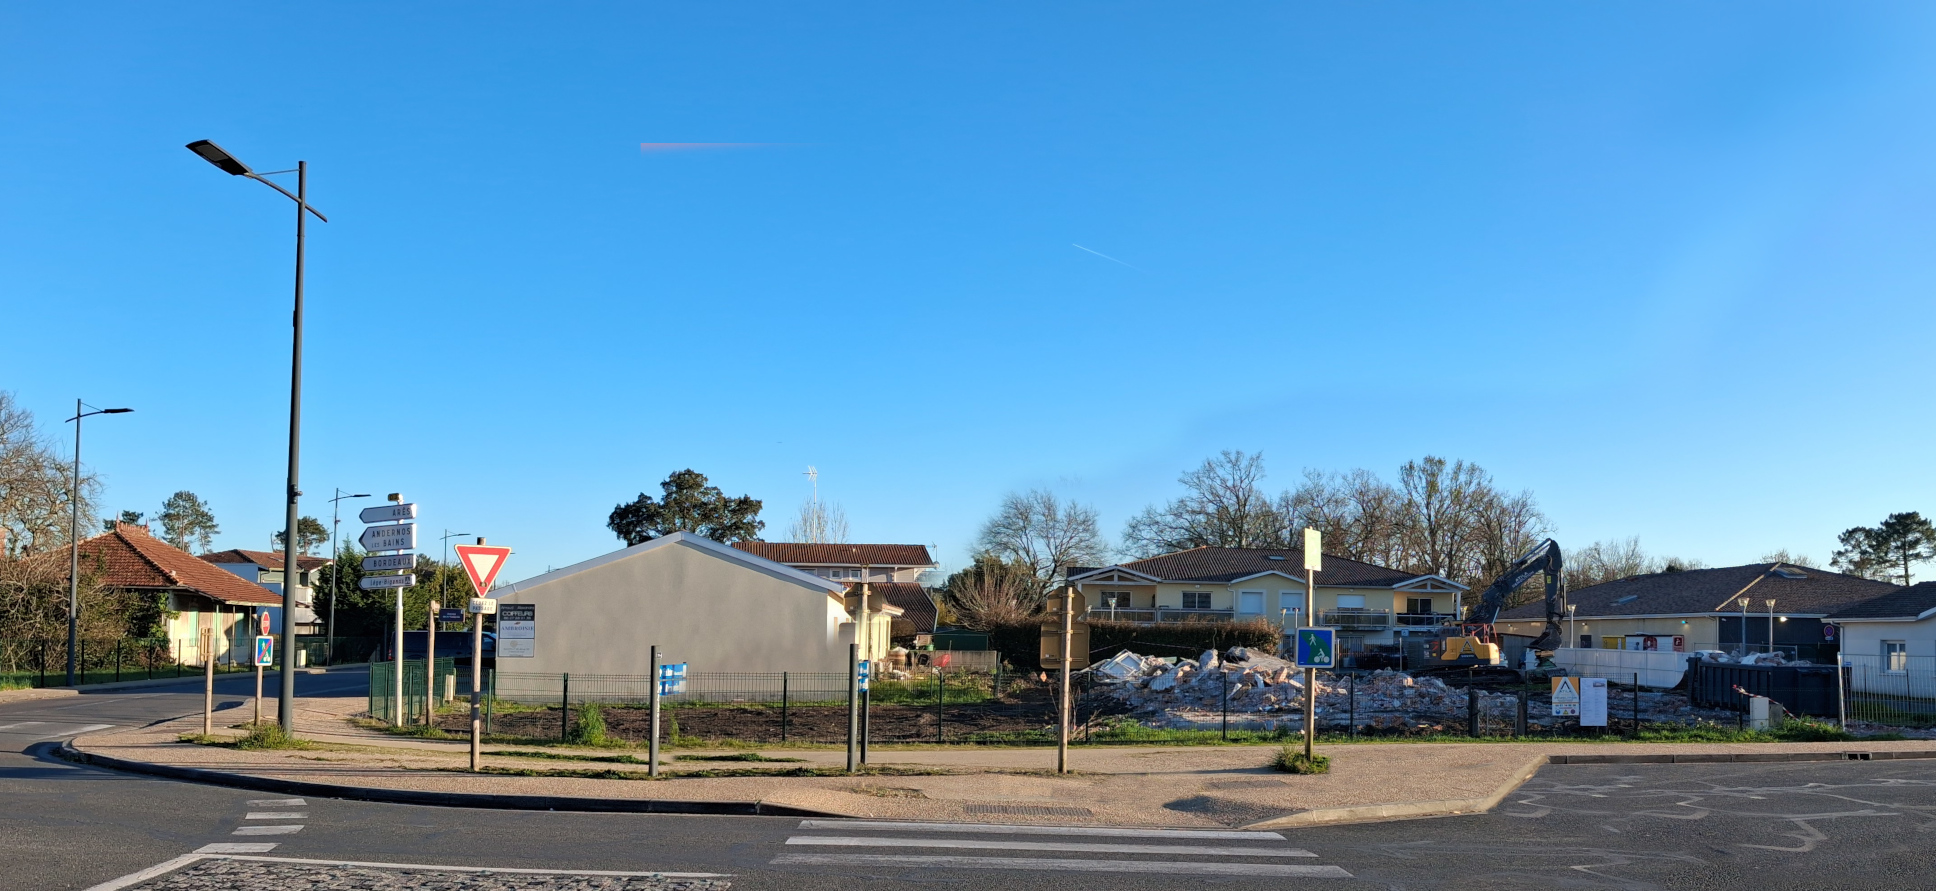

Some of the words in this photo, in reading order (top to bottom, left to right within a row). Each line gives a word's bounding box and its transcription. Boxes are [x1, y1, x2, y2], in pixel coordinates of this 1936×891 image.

[372, 528, 411, 538] ANDERNOS
[383, 538, 405, 547] BAINS
[373, 558, 412, 568] BORDEAUX
